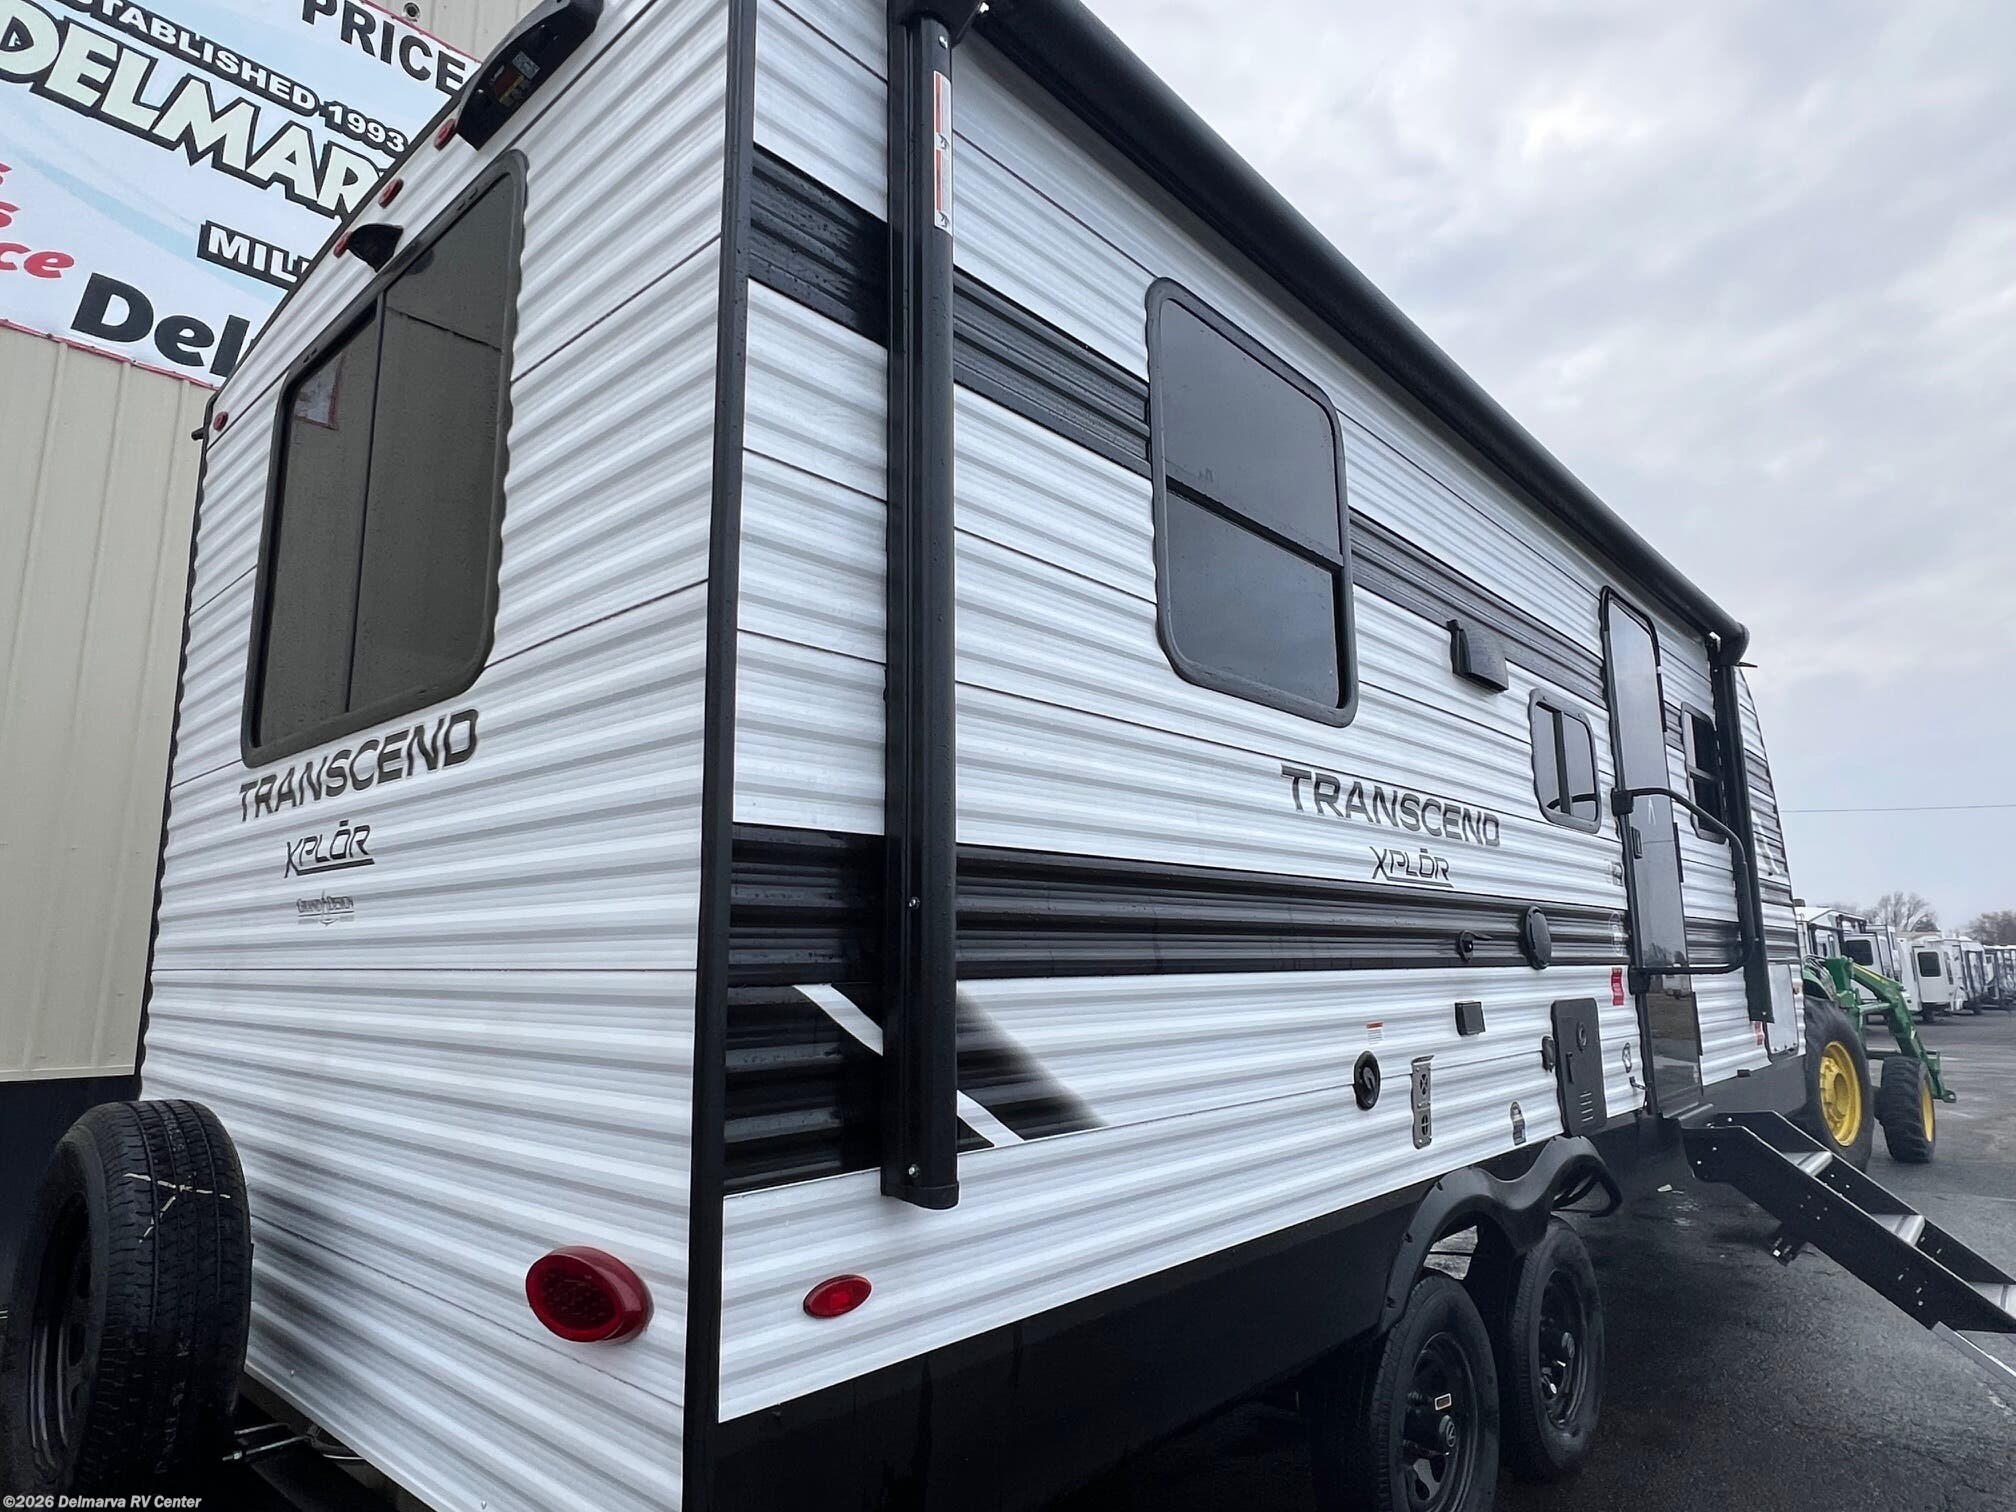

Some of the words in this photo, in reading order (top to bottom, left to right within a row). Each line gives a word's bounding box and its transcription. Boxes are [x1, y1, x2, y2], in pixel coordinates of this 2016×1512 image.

[77, 0, 317, 110] TABLISHED
[327, 104, 406, 152] 1993
[302, 0, 467, 95] PRICE
[0, 0, 382, 214] DELMAR
[71, 272, 253, 378] Del
[239, 708, 479, 822] TRANSCEND
[1281, 764, 1501, 848] TRANSCEND
